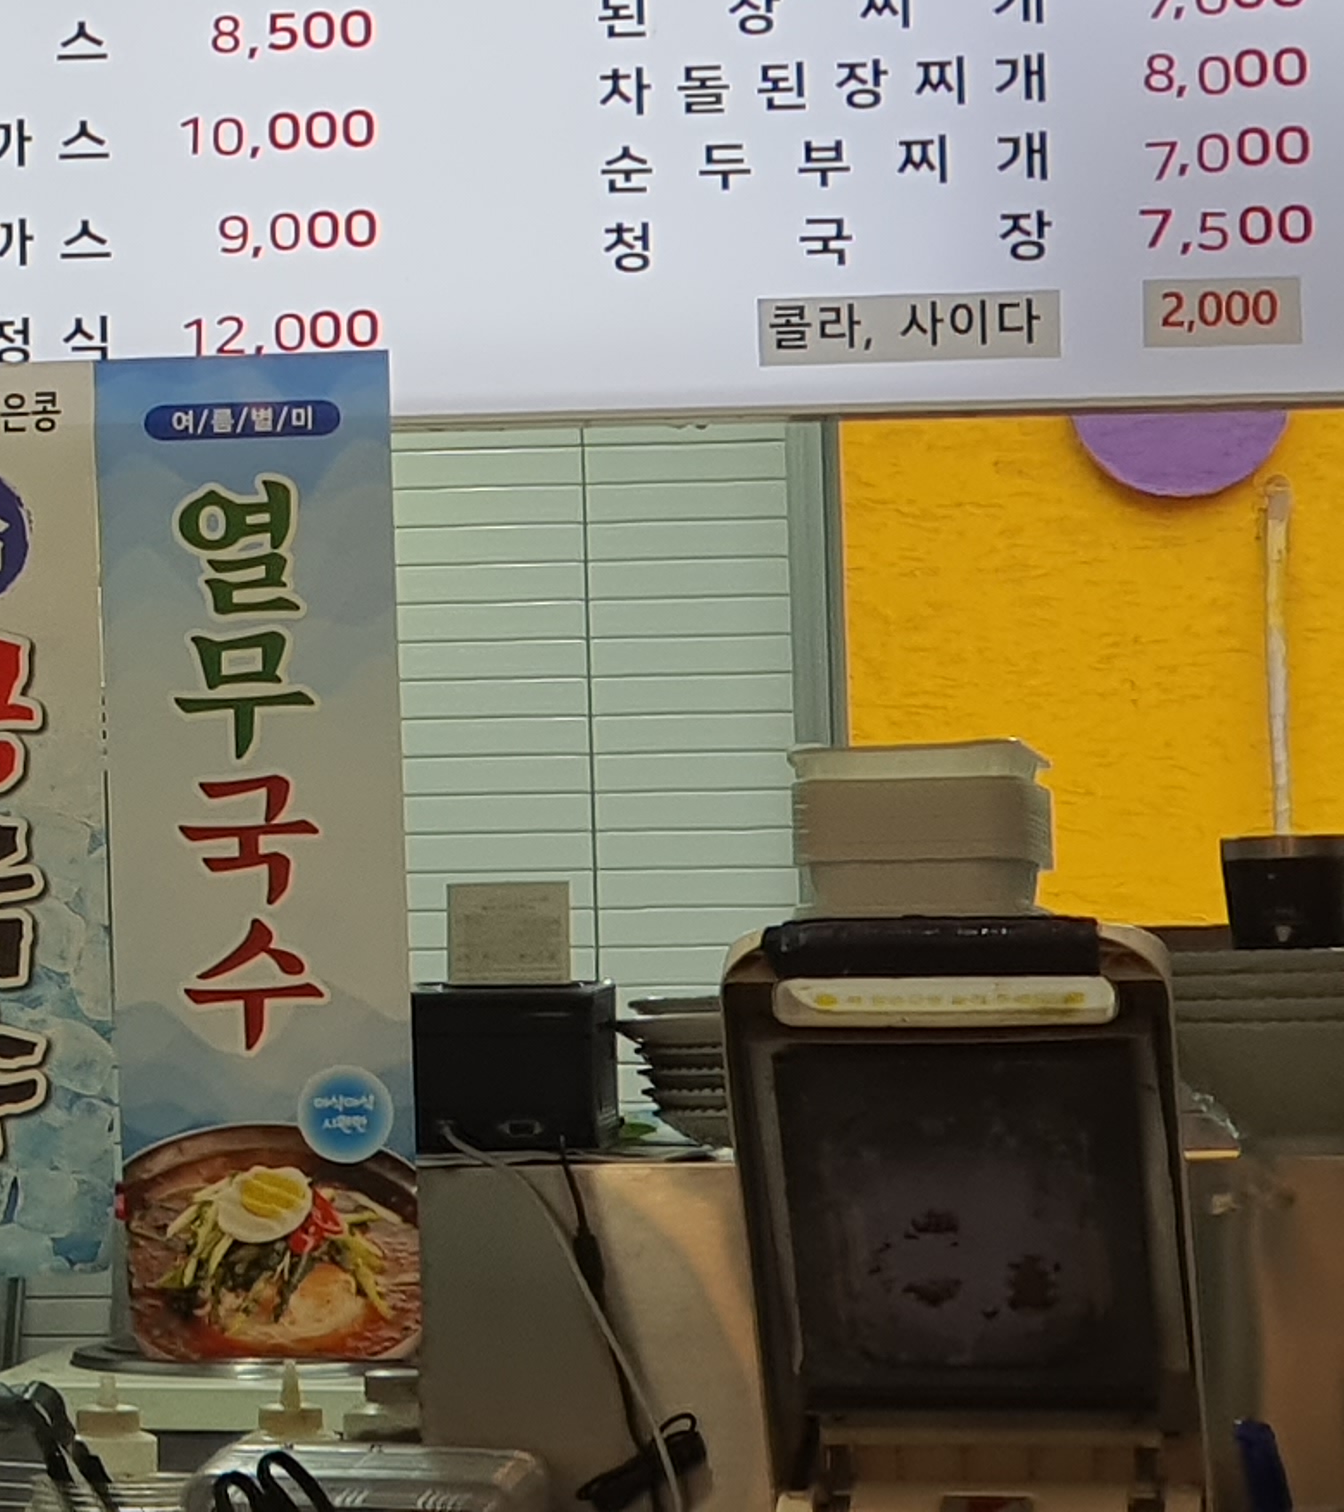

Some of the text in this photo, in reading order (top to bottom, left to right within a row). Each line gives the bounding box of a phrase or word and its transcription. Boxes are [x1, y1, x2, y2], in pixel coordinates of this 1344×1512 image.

[212, 10, 372, 59] 8,500
[1144, 47, 1306, 98] 8,000
[181, 110, 374, 159] 10,000
[1146, 126, 1309, 180] 7,000
[219, 209, 376, 258] 9,000
[1139, 205, 1312, 255] 7,500
[183, 309, 379, 357] 12,000
[768, 289, 1279, 351] 콜라, 사이다 2,000
[173, 478, 325, 1052] 열무국수
